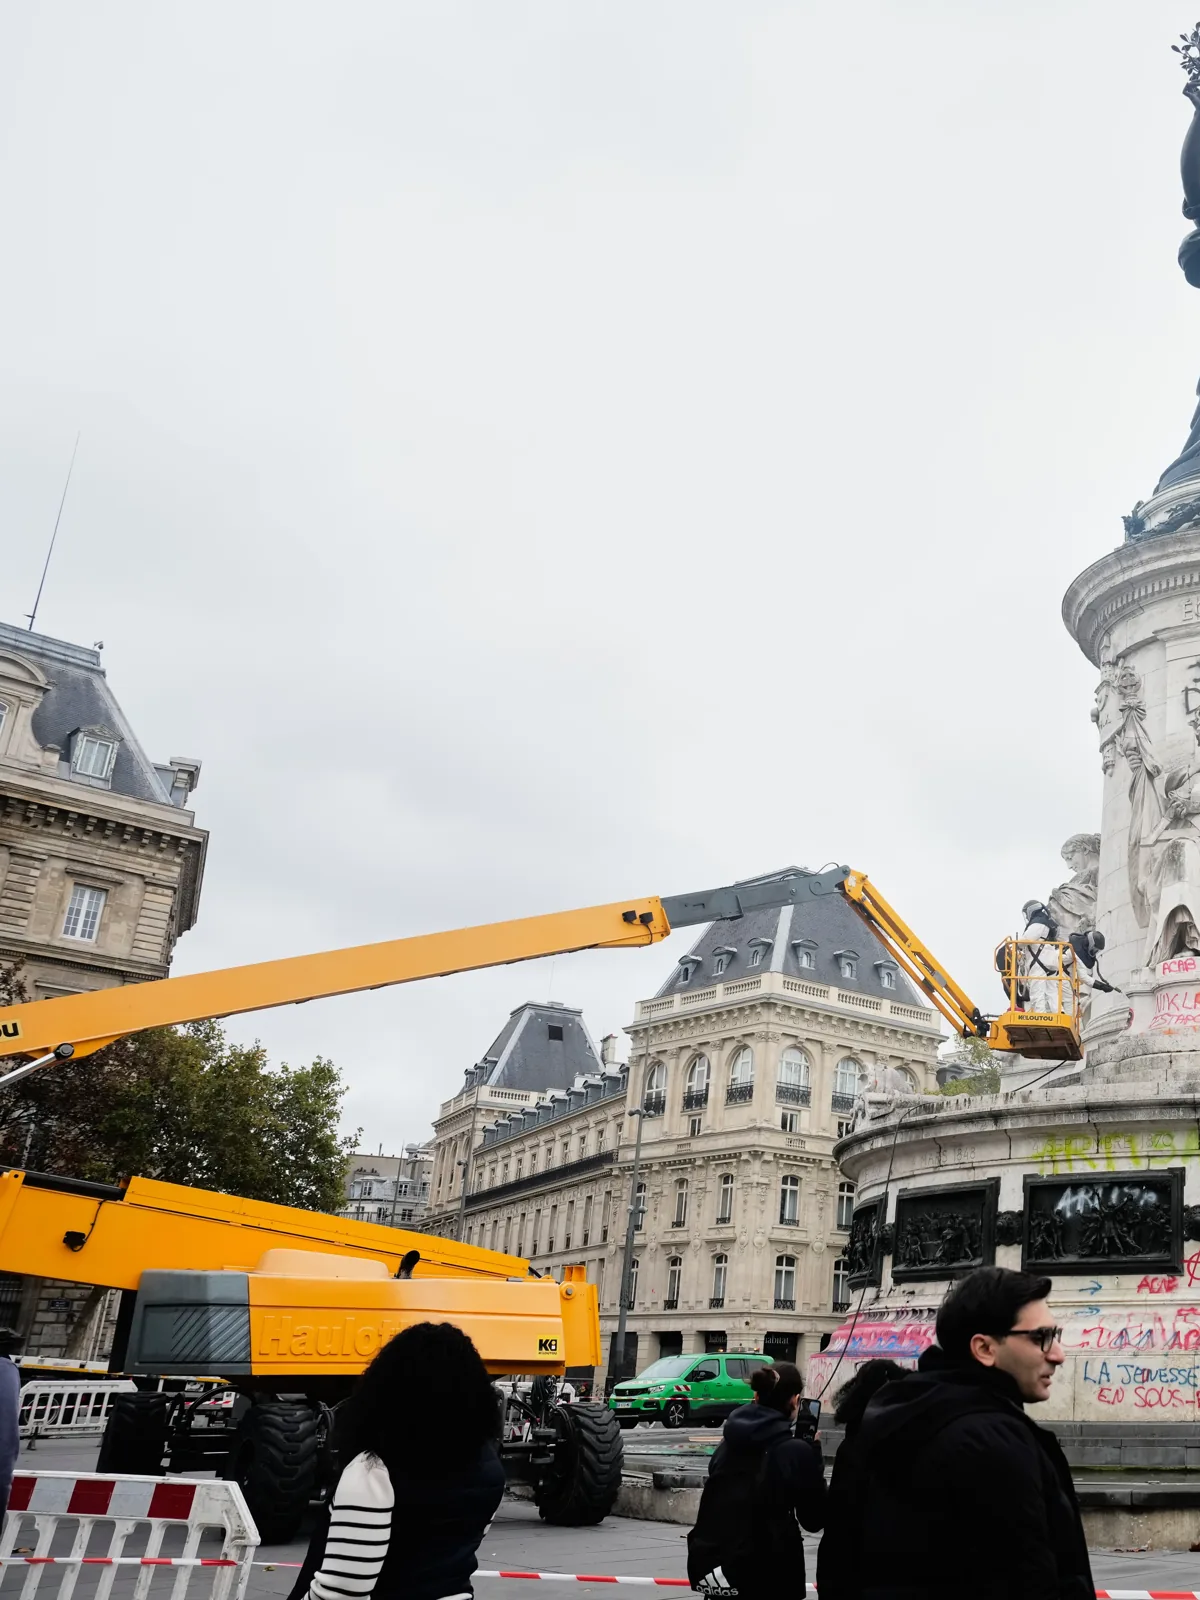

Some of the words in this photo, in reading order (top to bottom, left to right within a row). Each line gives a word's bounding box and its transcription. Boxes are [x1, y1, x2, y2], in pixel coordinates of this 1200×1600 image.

[1162, 957, 1197, 976] ACAB
[1083, 1361, 1110, 1384] LA
[1117, 1365, 1200, 1388] JEUNESSE
[1097, 1387, 1125, 1406] EN
[696, 1585, 739, 1597] adidas
